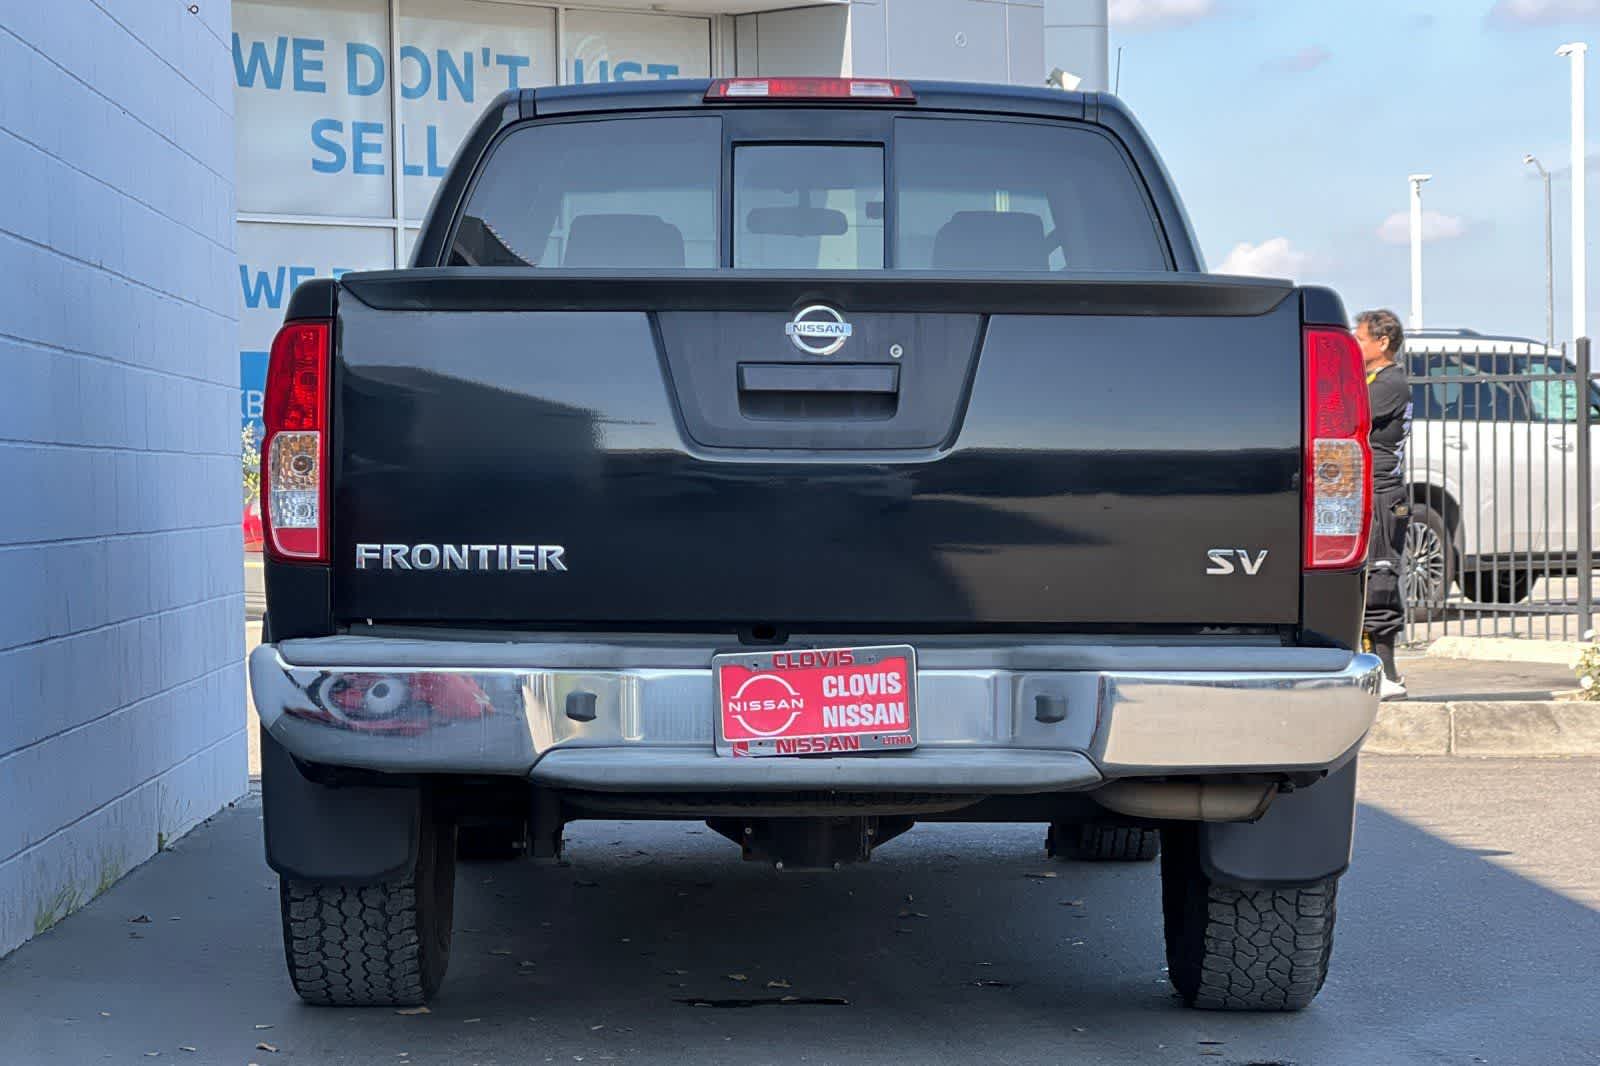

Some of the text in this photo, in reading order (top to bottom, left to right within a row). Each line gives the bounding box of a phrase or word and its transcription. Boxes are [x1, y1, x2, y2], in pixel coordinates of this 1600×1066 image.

[232, 32, 327, 94] WE
[346, 42, 530, 103] DON'T
[311, 118, 449, 177] SELL
[792, 324, 845, 333] NISSAN
[355, 543, 568, 571] FRONTIER
[1206, 548, 1269, 575] SV
[772, 650, 854, 669] CLOVIS
[822, 671, 902, 698] CLOVIS
[728, 698, 804, 713] NISSAN
[822, 702, 905, 728] NISSAN
[776, 735, 860, 754] NISSAN
